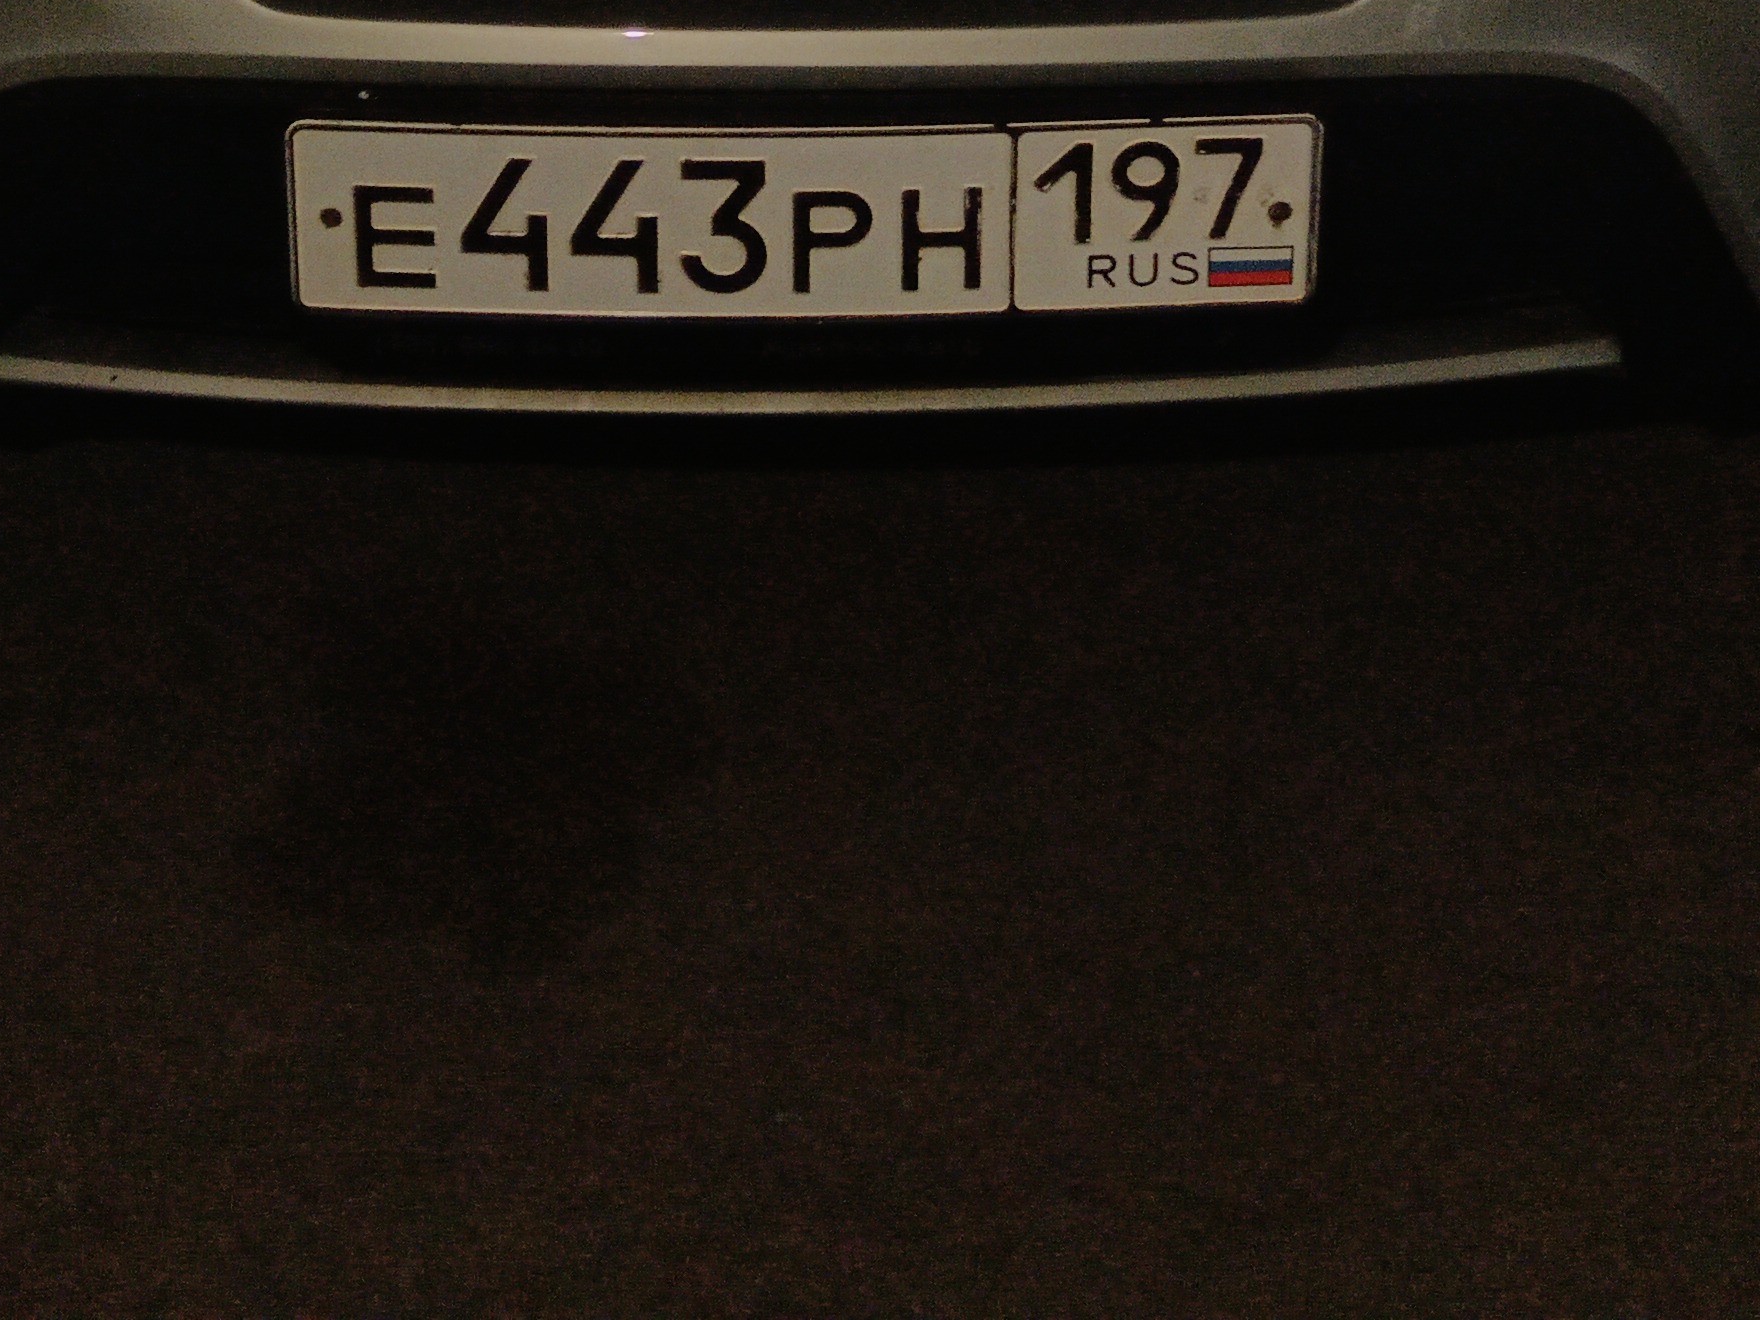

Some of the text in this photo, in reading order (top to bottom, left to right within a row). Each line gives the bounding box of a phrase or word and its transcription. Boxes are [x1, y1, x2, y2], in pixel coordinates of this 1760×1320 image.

[352, 135, 1264, 296] Е443РН 197
[1087, 249, 1200, 289] RUS
